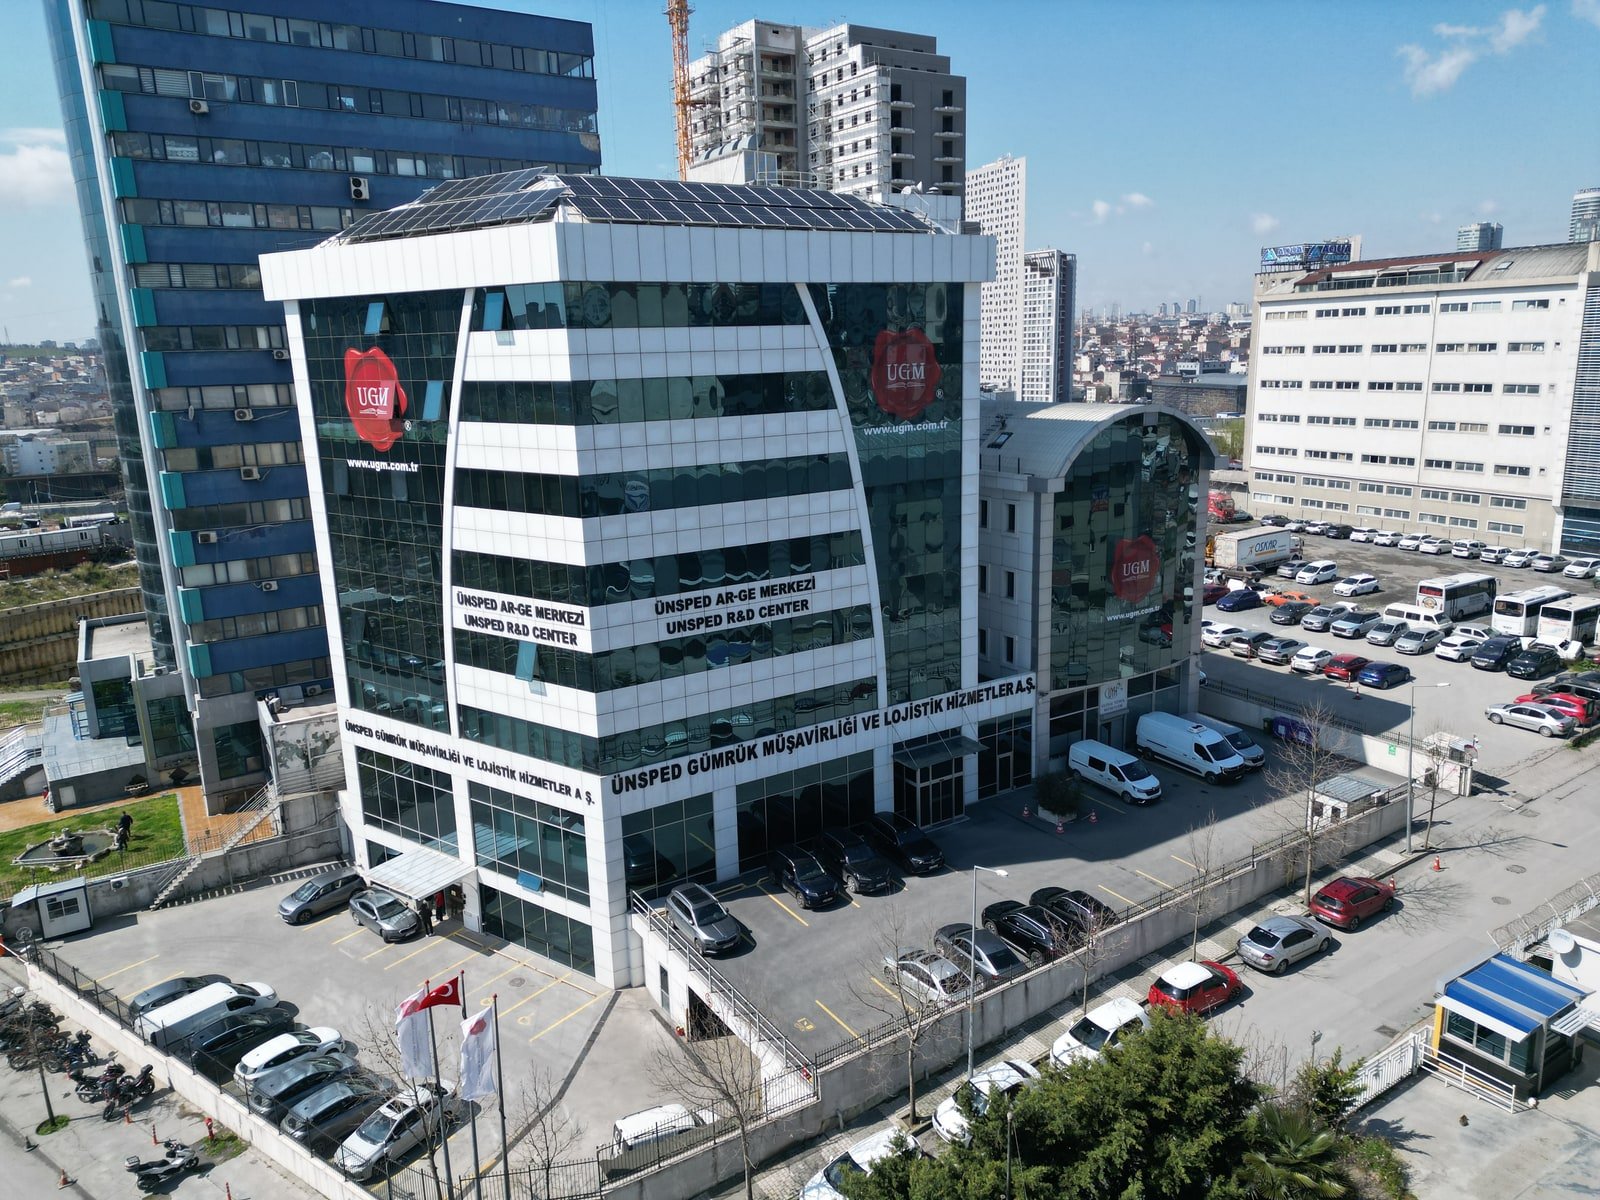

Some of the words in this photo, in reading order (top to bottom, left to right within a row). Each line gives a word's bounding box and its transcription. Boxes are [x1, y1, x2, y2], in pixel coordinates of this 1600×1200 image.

[887, 362, 926, 381] UGM
[863, 419, 949, 436] www.ugm.com.tr
[346, 458, 419, 473] www.ugm.com.tr
[1254, 540, 1278, 553] OSKAR
[1122, 559, 1150, 577] UGM
[457, 590, 498, 611] ÜNSPED
[500, 600, 533, 618] AR-GE
[535, 605, 585, 627] MERKEZİ
[654, 594, 712, 616] ÜNSPED
[715, 587, 756, 606] AR-GE
[760, 575, 816, 599] MERKEZİ
[666, 613, 723, 635] UNSPED
[726, 608, 755, 625] R&D
[758, 598, 810, 619] CENTER
[1106, 605, 1161, 622] www.ugm.com.tr
[463, 613, 505, 633] UNSPED
[506, 621, 530, 637] R&D
[532, 626, 578, 647] CENTER
[611, 763, 683, 796] ÜNSPED
[686, 743, 759, 776] GÜMRÜK
[762, 715, 859, 758] MÜŞAVİRLİĞİ
[861, 712, 880, 732] VE
[884, 697, 944, 727] LOJİSTİK
[946, 683, 1014, 711] HİZMETLER
[344, 719, 374, 738] ÜNSPED
[374, 729, 408, 749] GÜMRÜK
[462, 754, 475, 769] VE
[476, 759, 517, 782] LOJİSTİK
[518, 770, 572, 798] HİZMETLER
[574, 787, 583, 800] A
